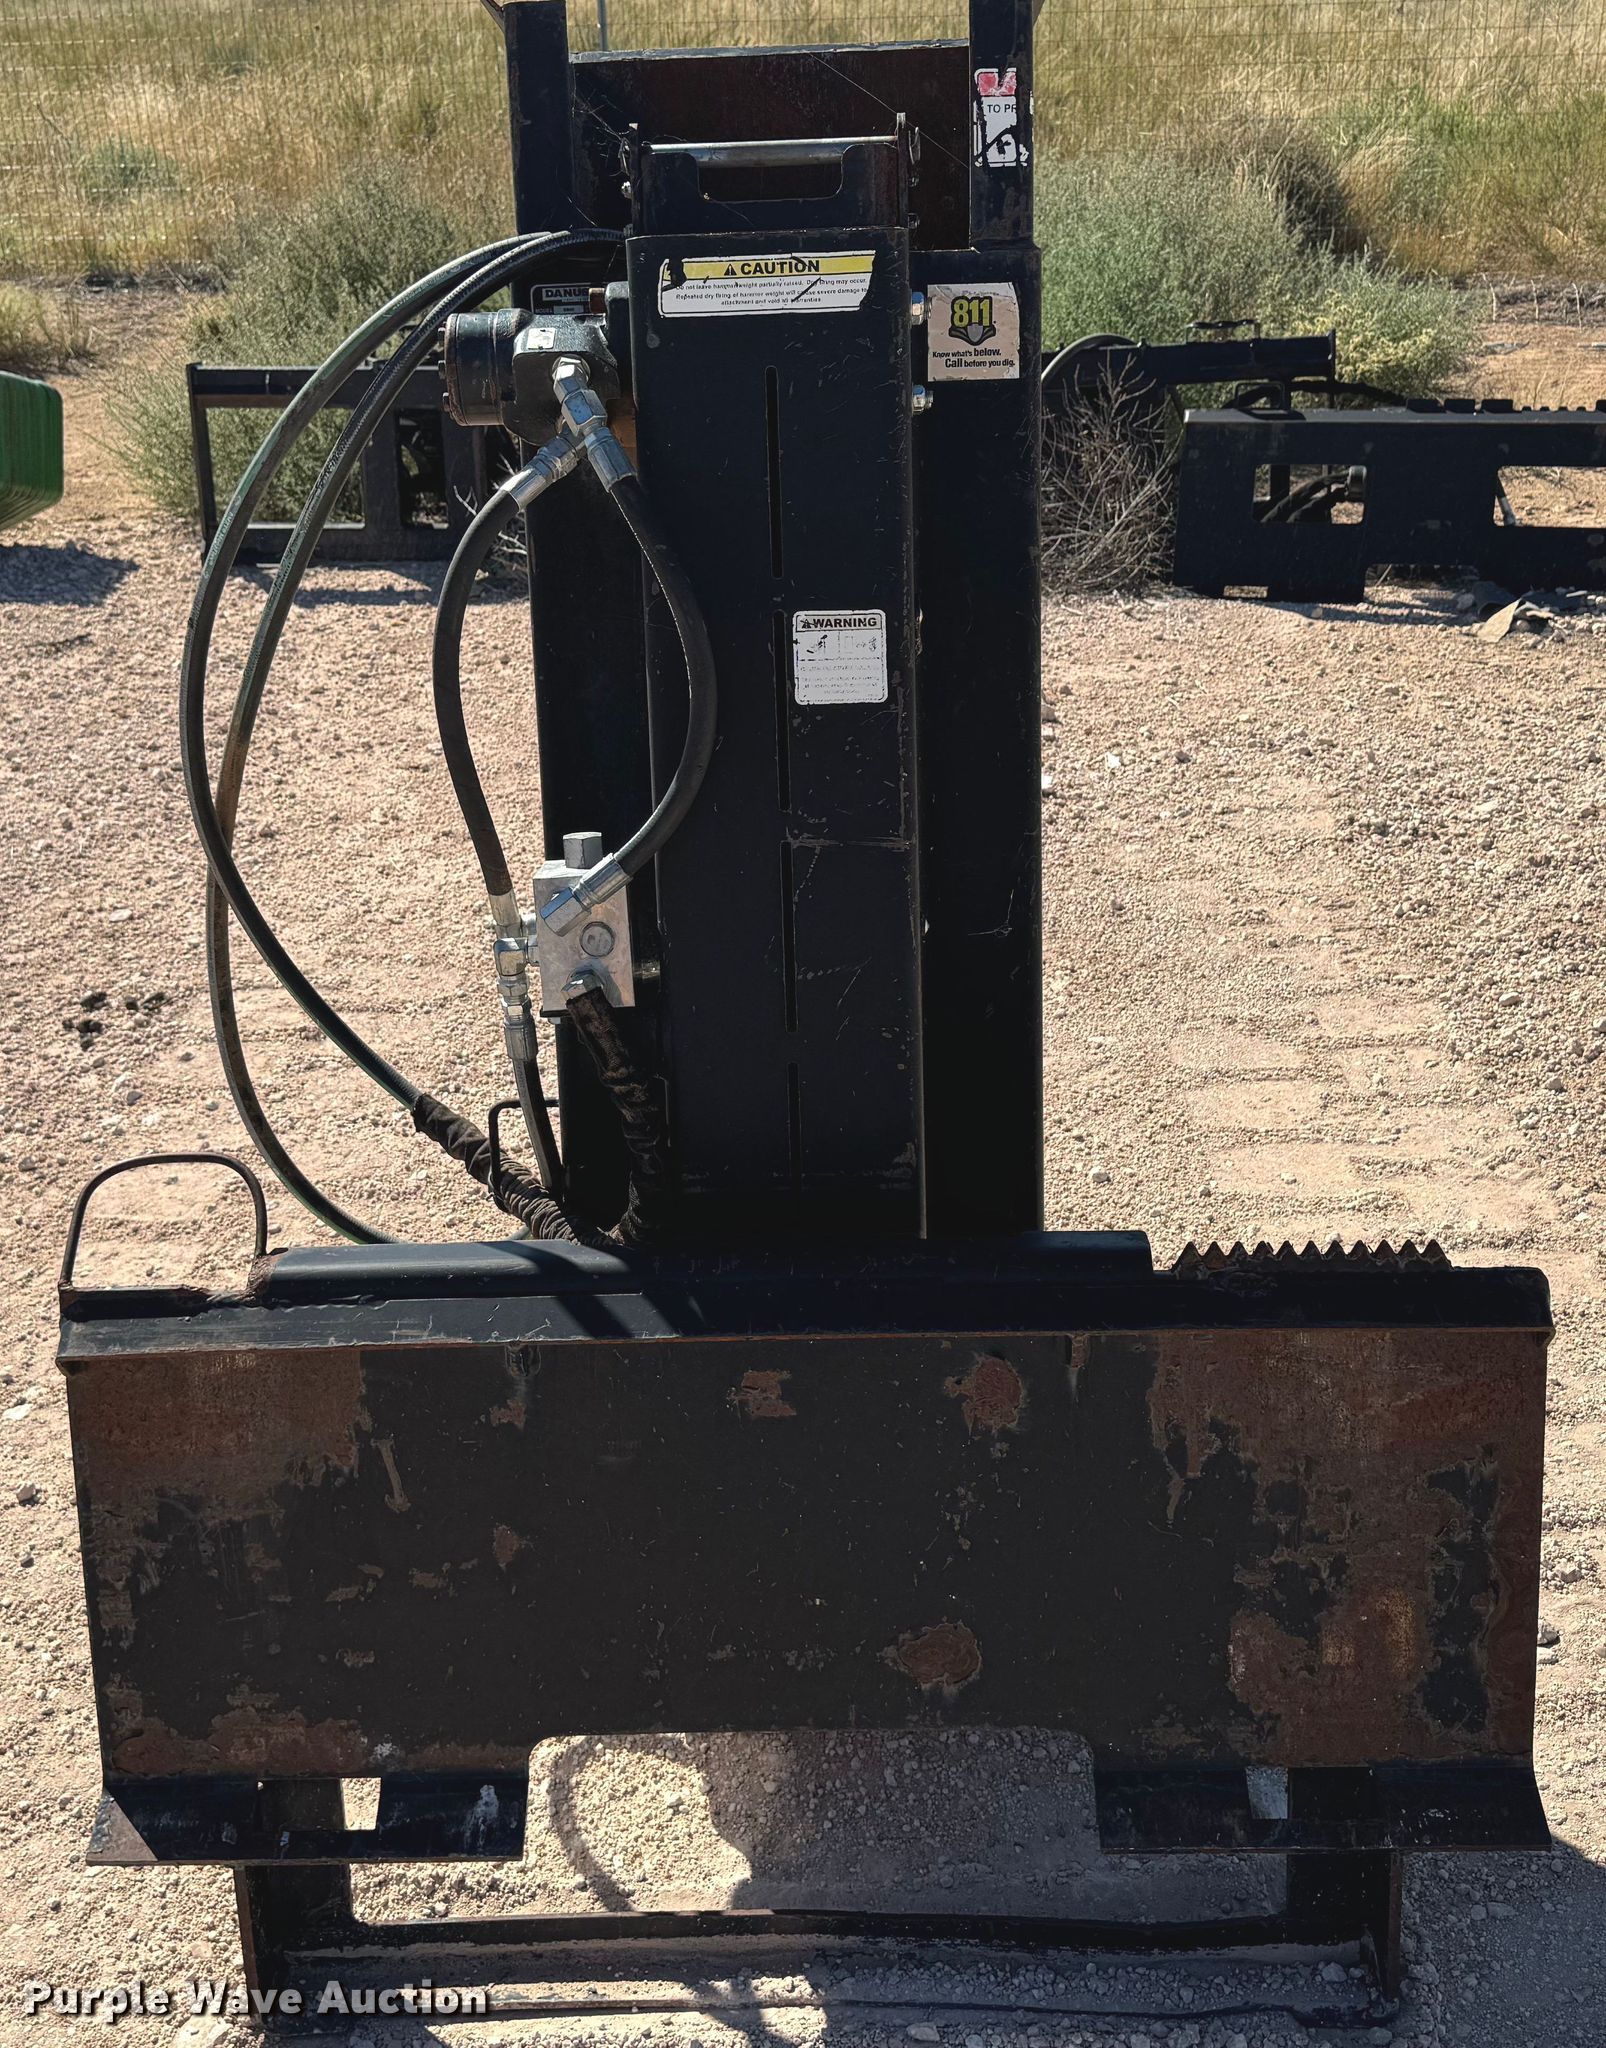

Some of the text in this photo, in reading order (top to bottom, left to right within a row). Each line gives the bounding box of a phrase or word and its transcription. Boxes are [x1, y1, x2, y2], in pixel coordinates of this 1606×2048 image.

[987, 104, 1001, 113] TO
[740, 260, 820, 276] CAUTION
[952, 297, 992, 329] 811
[932, 348, 1001, 359] Know what's below.
[945, 358, 1015, 369] Call before you dig.
[813, 617, 877, 629] WARNING
